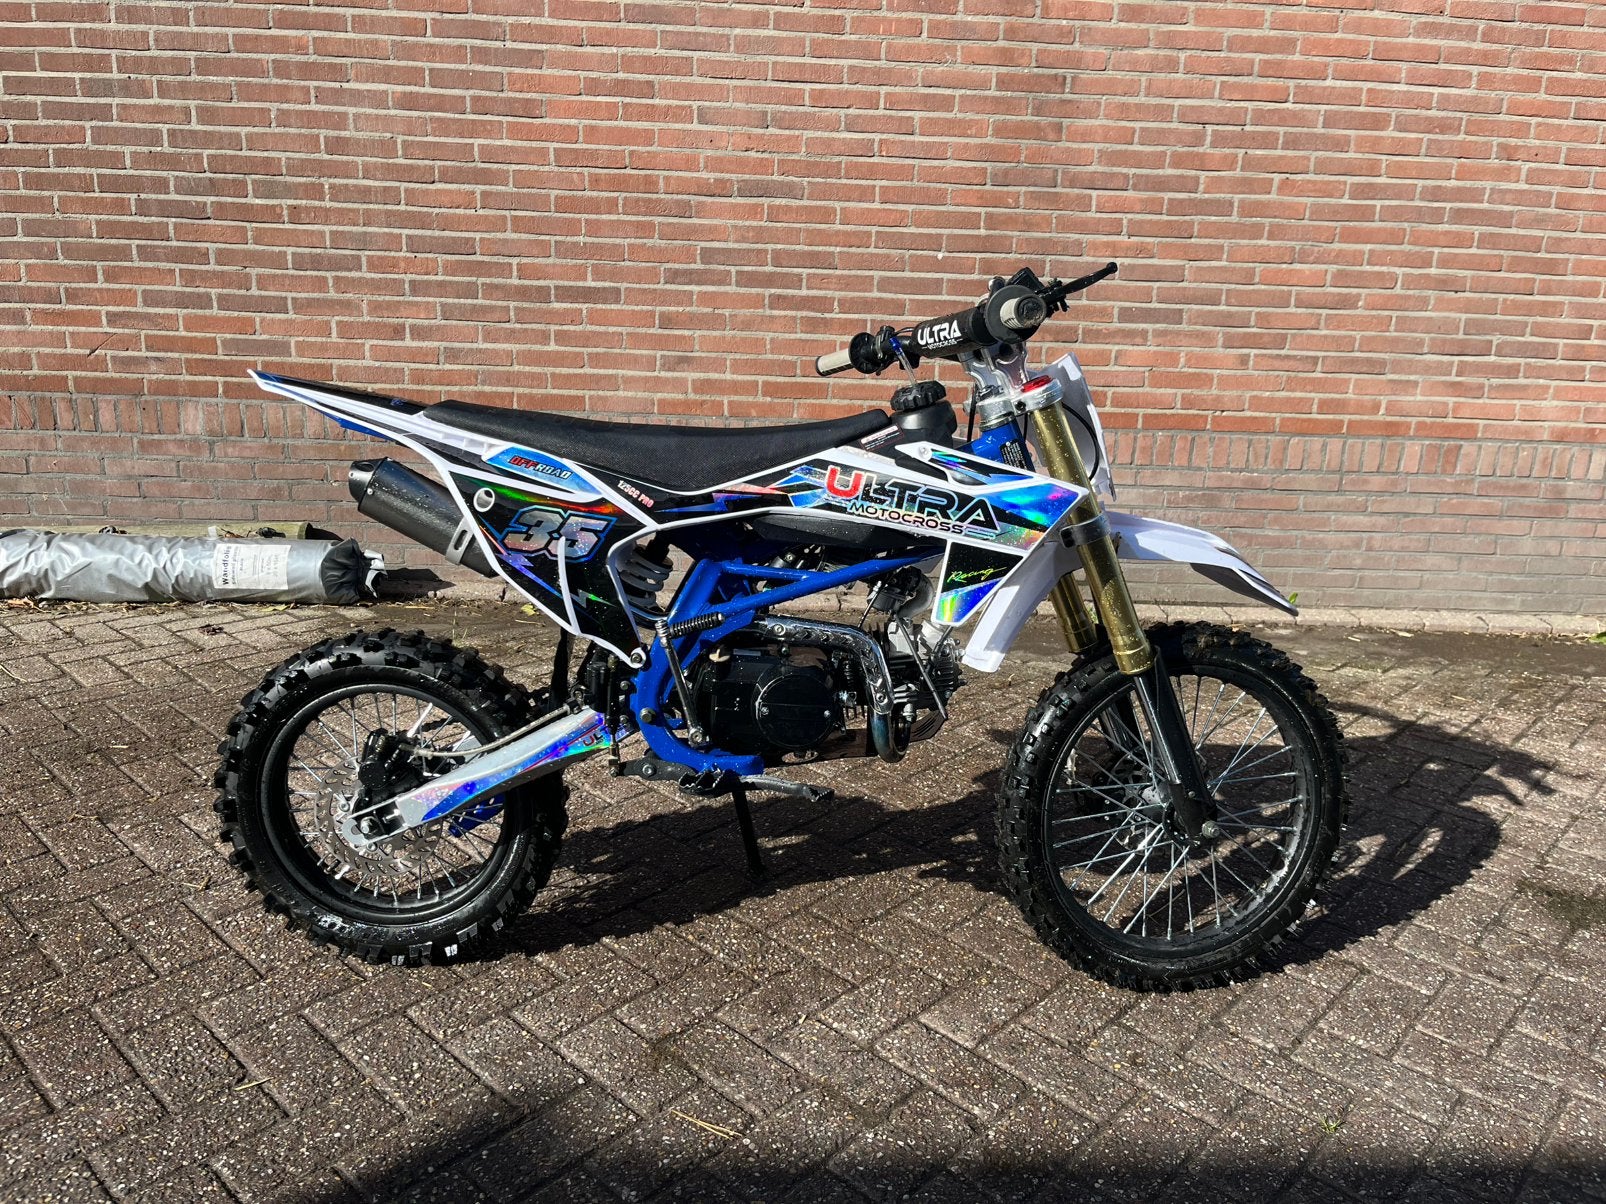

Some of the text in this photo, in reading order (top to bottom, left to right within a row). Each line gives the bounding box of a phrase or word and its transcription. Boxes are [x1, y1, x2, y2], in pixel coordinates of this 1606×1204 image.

[917, 319, 962, 346] ULTRA
[617, 480, 655, 508] 125CC PRO
[825, 465, 1001, 532] ULTRA
[502, 508, 611, 560] 35
[849, 502, 964, 535] MOTOCROSS
